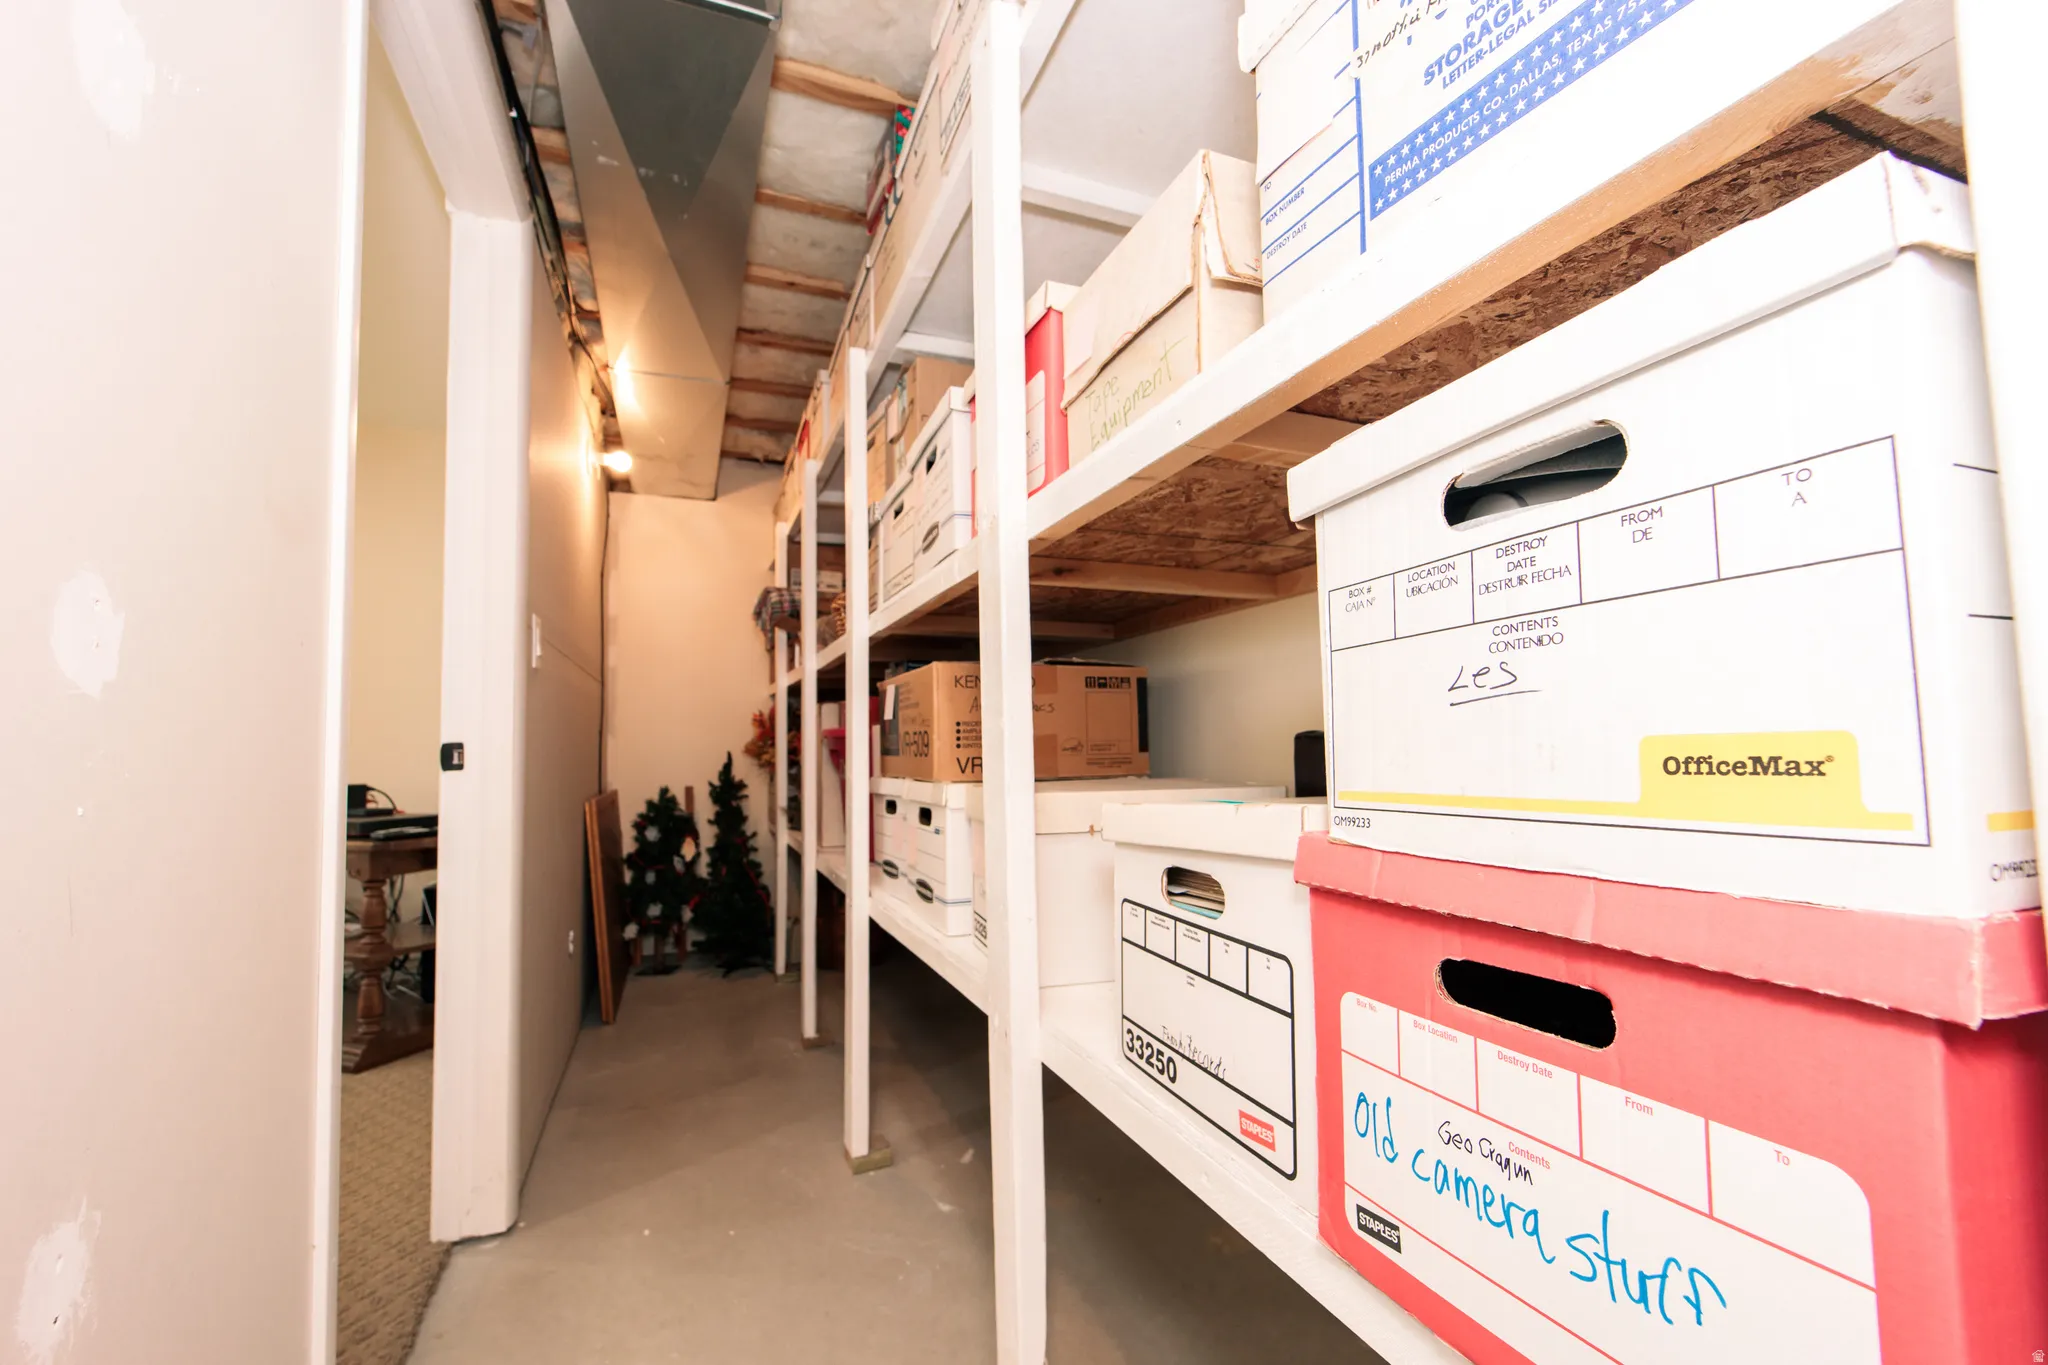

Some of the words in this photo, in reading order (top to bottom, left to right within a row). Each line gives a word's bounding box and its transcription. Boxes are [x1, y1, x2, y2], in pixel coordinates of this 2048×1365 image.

[1466, 0, 1500, 29] POR
[1423, 0, 1524, 86] STORAGE
[1442, 9, 1535, 89] LETTER-LEGAL
[1384, 155, 1420, 186] PERMA
[1422, 111, 1480, 160] PRODUCTS
[1566, 15, 1612, 56] TEXAS
[1263, 181, 1272, 192] TO
[1265, 210, 1278, 226] BOX
[1279, 187, 1305, 214] NUMBER
[1266, 235, 1290, 259] DESTROY
[1291, 221, 1307, 238] DATE
[1781, 468, 1812, 486] TO
[1791, 492, 1807, 508] A
[1620, 506, 1663, 527] FROM
[1632, 527, 1653, 543] DE
[1495, 535, 1548, 559] DESTROY
[1407, 561, 1456, 584] LOCATION
[1506, 556, 1537, 573] DATE
[1405, 575, 1459, 598] UBICACIÓN
[1478, 573, 1528, 595] DESTRUIR
[1531, 565, 1572, 582] FECHA
[1348, 587, 1365, 599] BOX
[1345, 599, 1365, 613] CAJA
[1492, 615, 1559, 636] CONTENTS
[1488, 632, 1564, 654] CONTENIDO
[1333, 816, 1371, 828] OM99233
[1356, 998, 1367, 1008] Box
[1413, 1019, 1426, 1031] Box
[1428, 1024, 1458, 1043] Location
[1126, 1028, 1177, 1084] 33250
[1497, 1050, 1530, 1072] Destroy
[1532, 1065, 1553, 1079] Date
[1624, 1096, 1654, 1117] From
[1240, 1117, 1274, 1144] STAPLES
[1437, 1120, 1473, 1154] Geo
[1508, 1141, 1551, 1170] Contents
[1773, 1148, 1791, 1166] To
[1354, 1091, 1399, 1163] Old
[1411, 1148, 1556, 1264] camera
[1565, 1209, 1727, 1327] stuff
[1359, 1211, 1400, 1244] STAPLES
